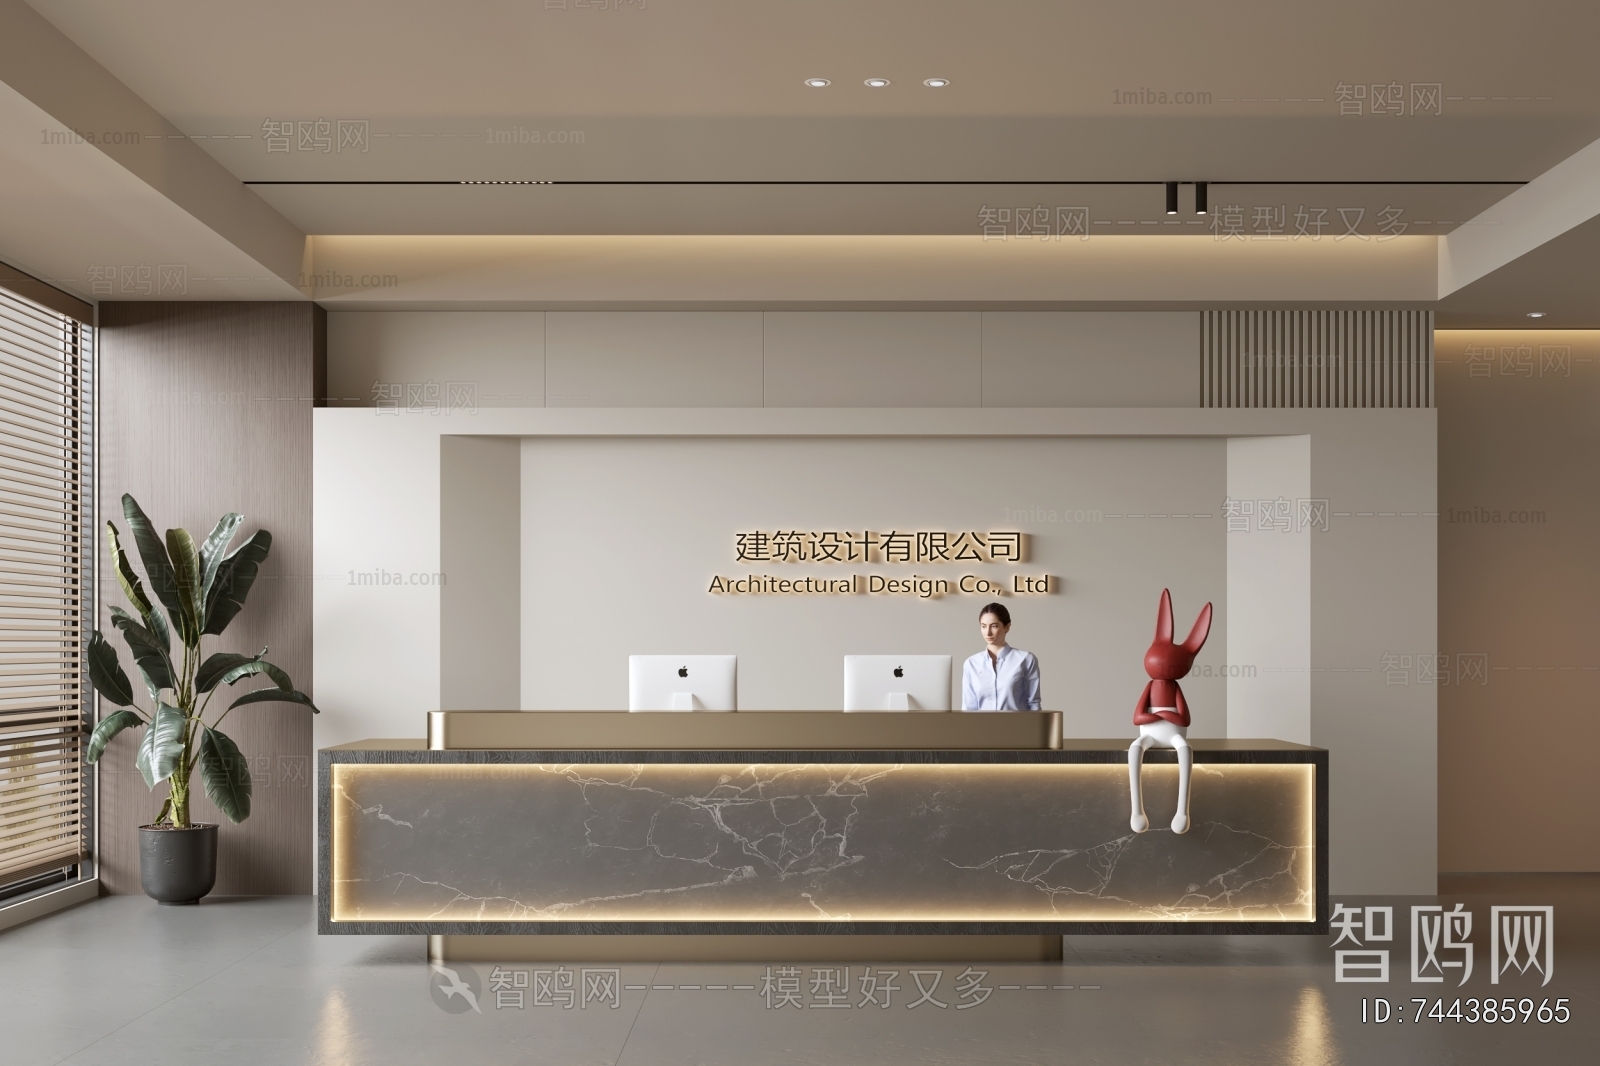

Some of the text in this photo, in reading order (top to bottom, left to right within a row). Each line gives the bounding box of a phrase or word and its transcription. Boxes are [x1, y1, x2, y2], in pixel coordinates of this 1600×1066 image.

[735, 530, 1021, 562] 建筑设计有限公司
[708, 574, 1049, 598] Architectural Design Co., Ltd
